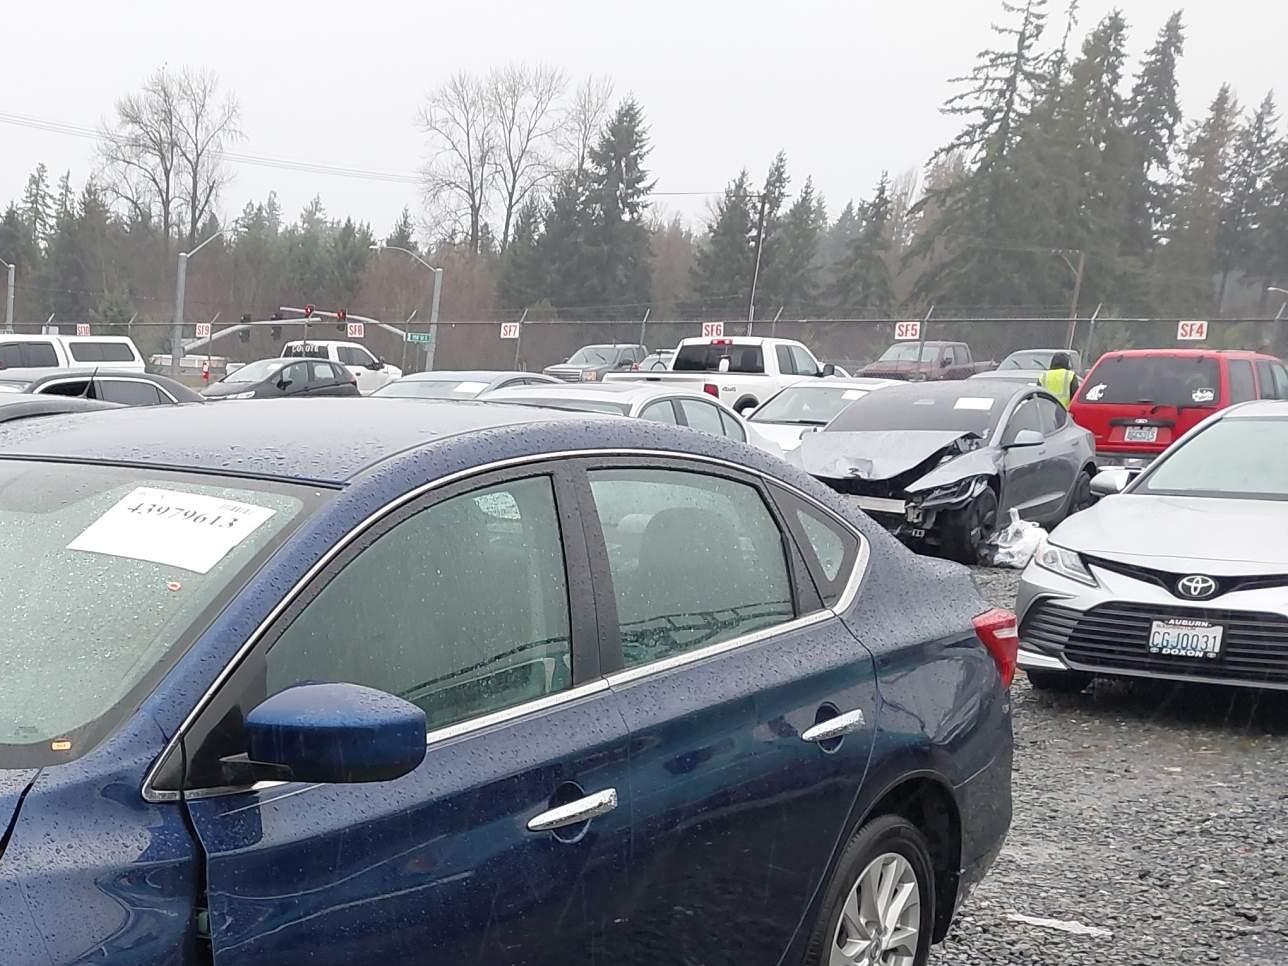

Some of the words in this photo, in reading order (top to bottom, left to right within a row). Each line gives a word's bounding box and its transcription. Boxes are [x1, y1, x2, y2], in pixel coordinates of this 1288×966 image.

[197, 324, 210, 335] SF9
[502, 324, 518, 337] SF7
[703, 323, 722, 337] SF6
[897, 323, 918, 337] SF5
[1180, 322, 1205, 338] SF4
[127, 502, 239, 528] 43979613
[1151, 631, 1217, 653] CGJ0031
[1161, 648, 1204, 658] DOXON
